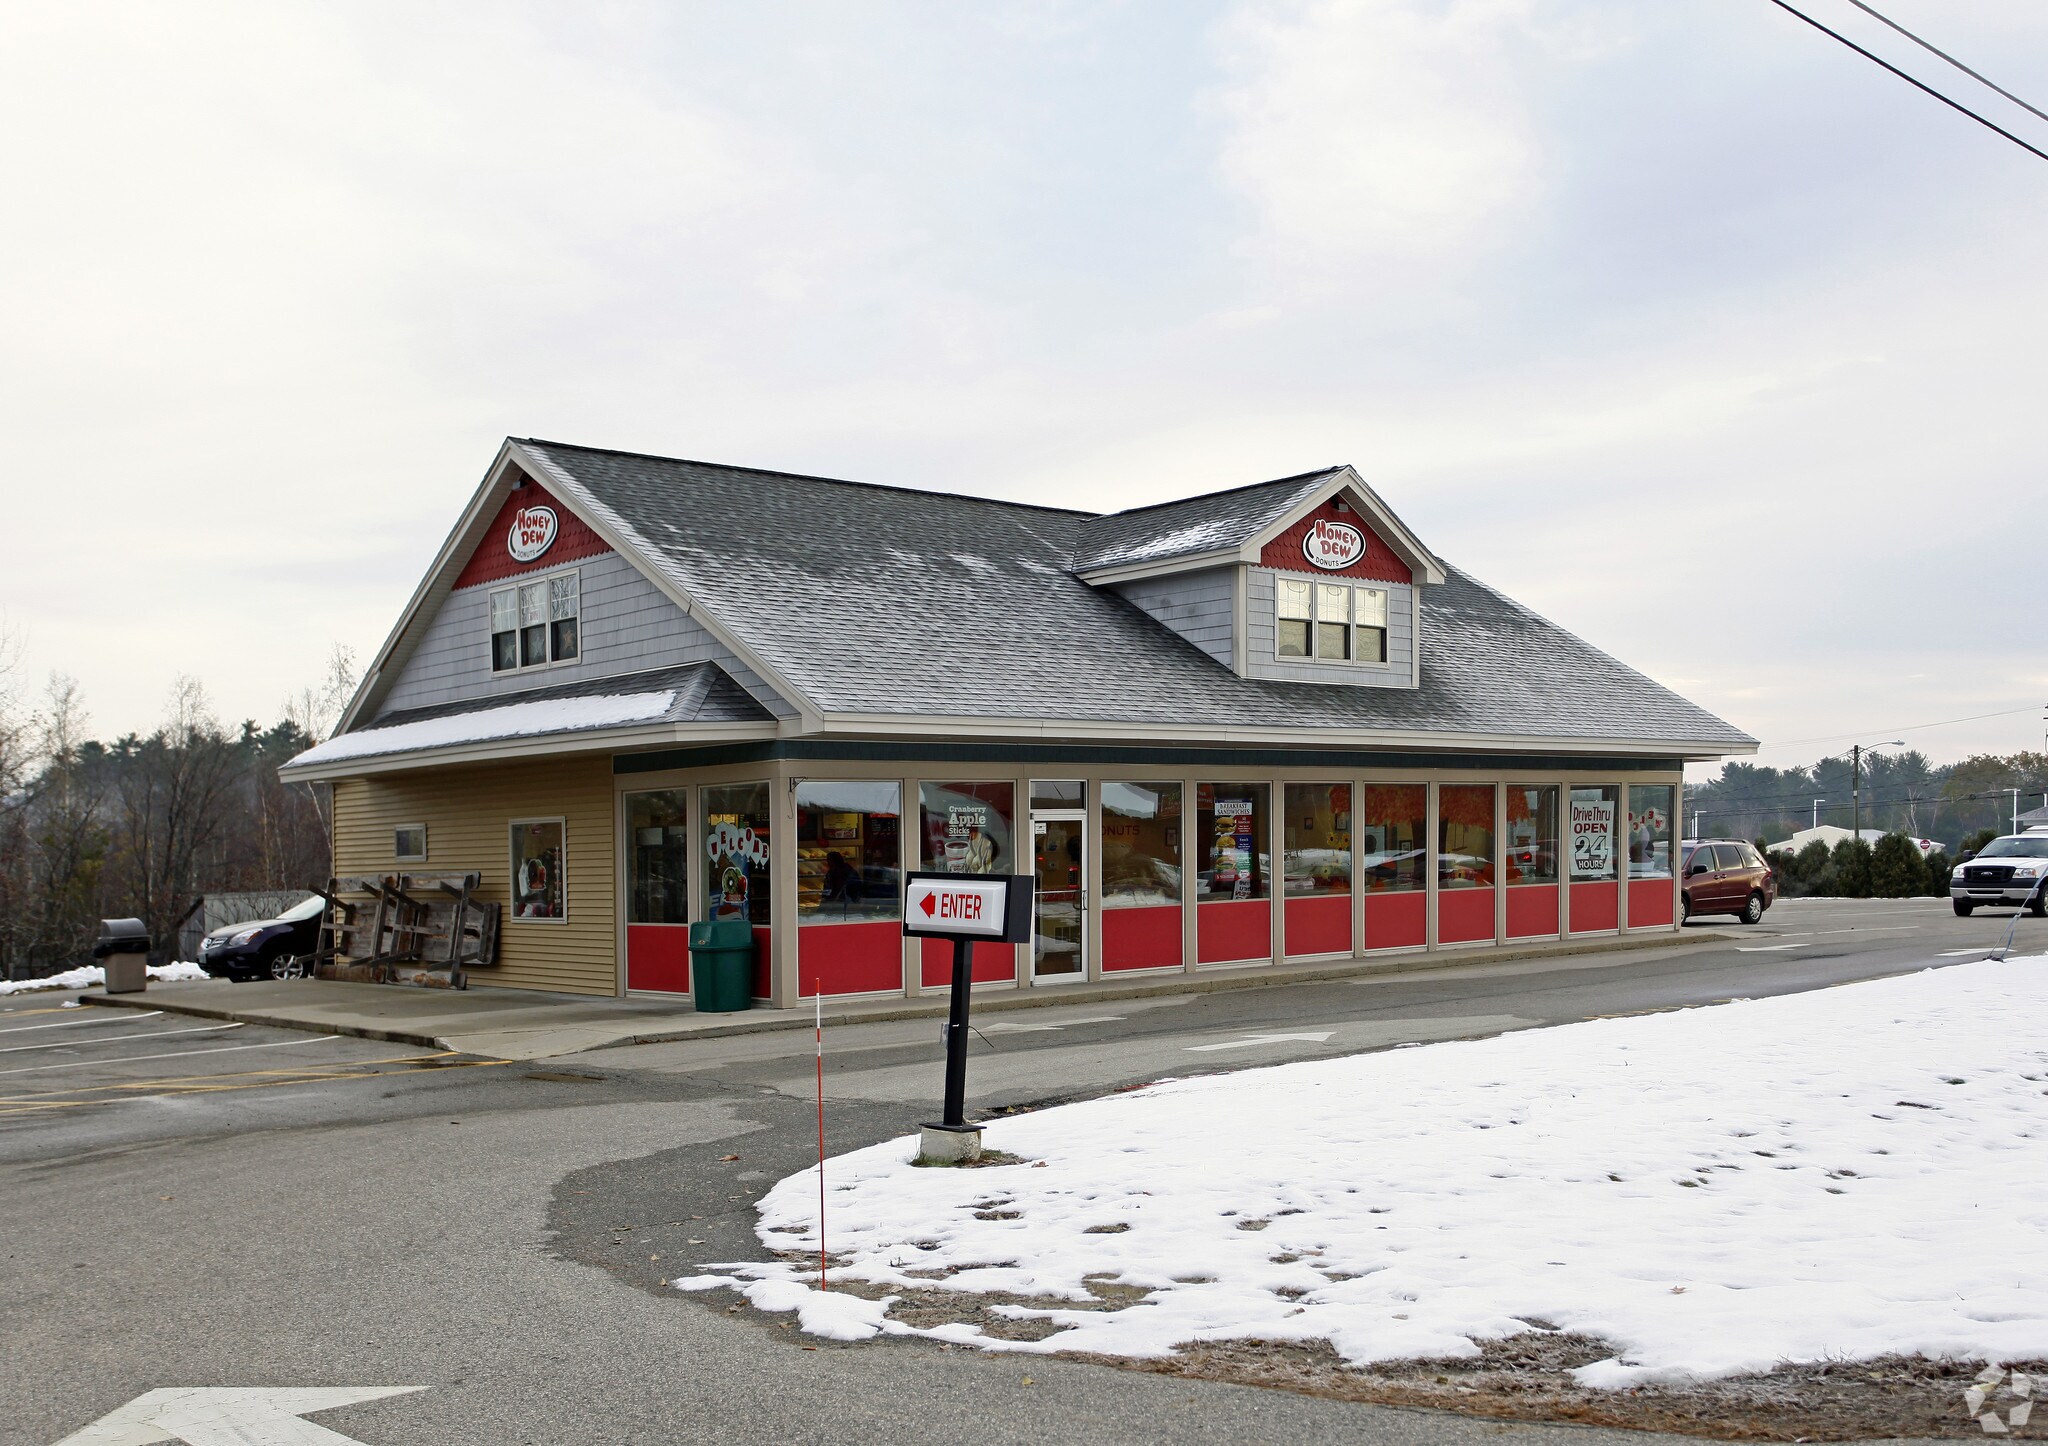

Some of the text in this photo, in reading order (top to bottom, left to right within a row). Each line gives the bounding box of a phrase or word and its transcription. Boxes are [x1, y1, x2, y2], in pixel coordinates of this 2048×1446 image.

[517, 509, 550, 531] HONEY
[521, 530, 546, 546] DEW
[1315, 520, 1357, 547] HONEY
[517, 549, 536, 558] DONUTS
[1320, 540, 1352, 558] DEW
[1315, 556, 1340, 567] DONUTS
[948, 805, 987, 813] Cranberry
[948, 813, 986, 827] Apple
[948, 827, 970, 835] Sticks
[1573, 823, 1608, 834] OPEN
[711, 828, 768, 858] WELCOME
[1574, 836, 1609, 860] 24
[1578, 860, 1605, 870] HOURS
[940, 893, 982, 920] ENTER
